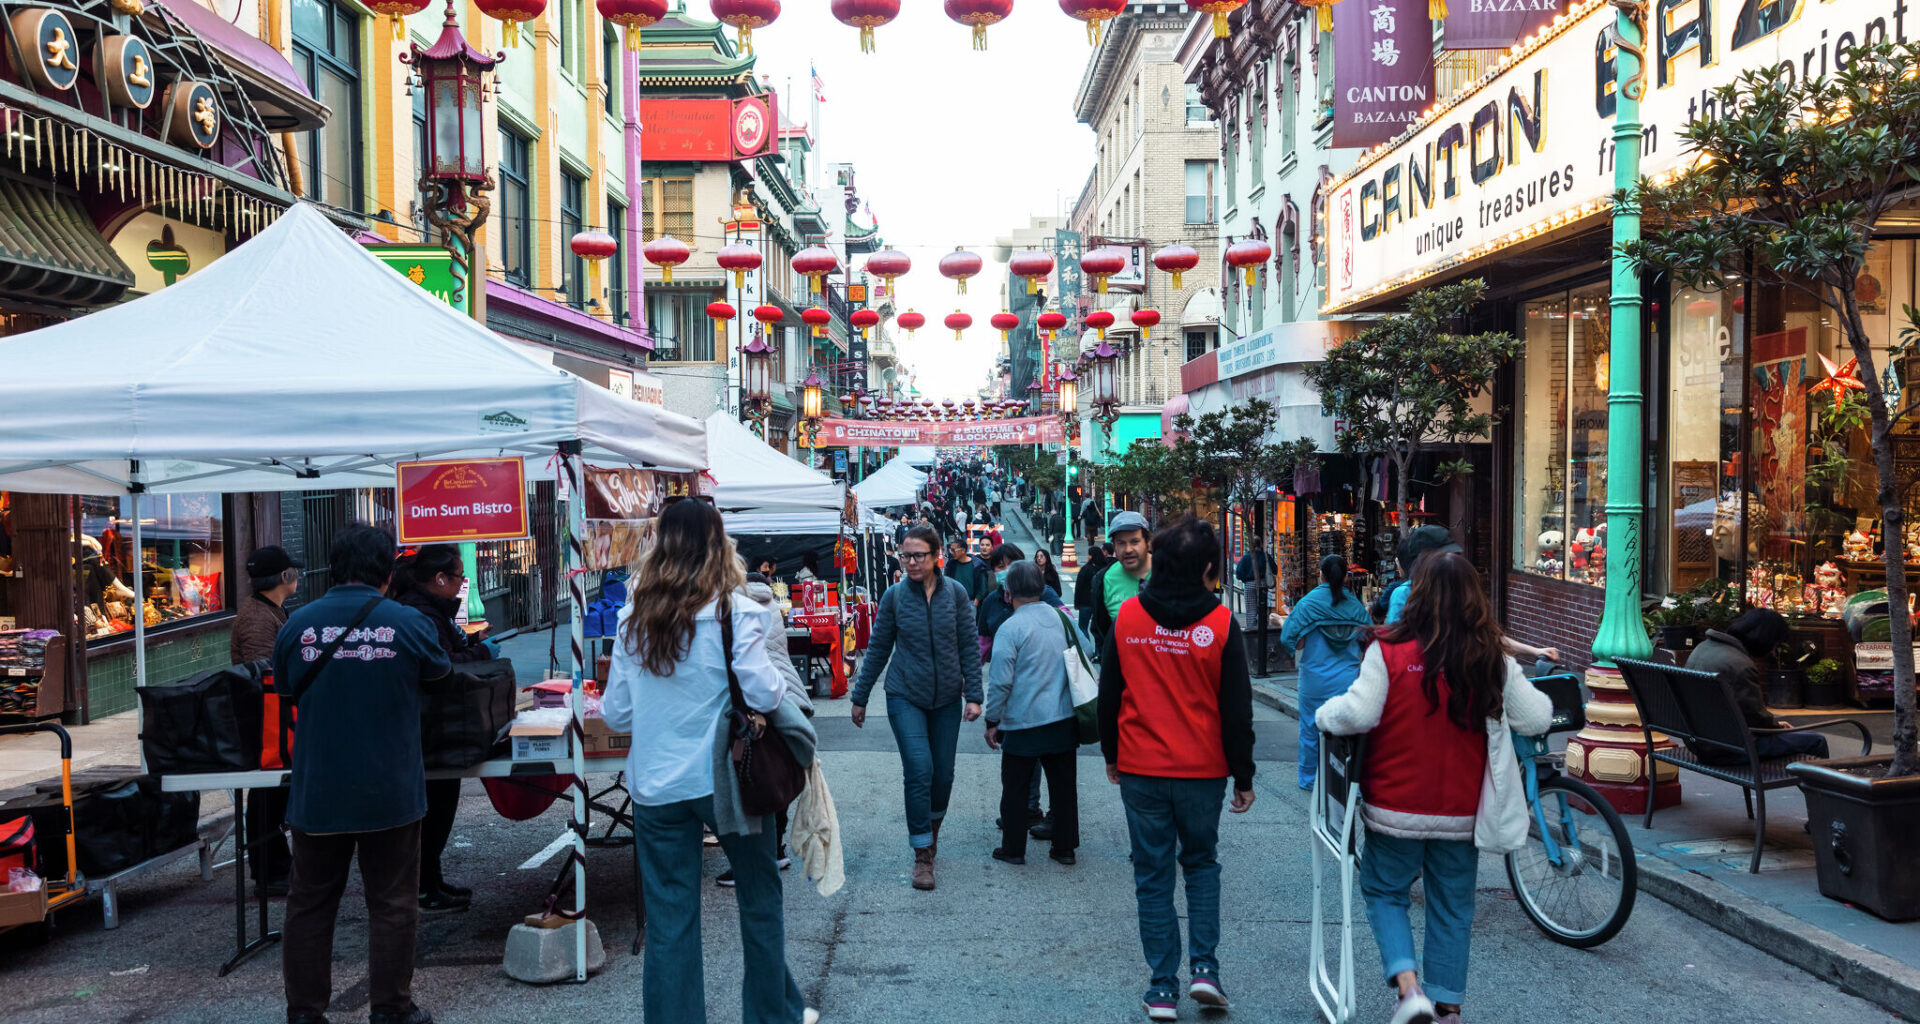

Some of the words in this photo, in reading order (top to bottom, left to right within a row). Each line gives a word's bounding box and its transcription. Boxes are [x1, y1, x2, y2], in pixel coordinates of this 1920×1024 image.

[1470, 0, 1557, 13] BAZAAR
[1369, 0, 1401, 67] 商場
[1347, 85, 1427, 103] CANTON
[1354, 110, 1417, 124] BAZAAR
[1360, 68, 1548, 242] CANTON
[1416, 215, 1463, 256] unique
[1479, 164, 1575, 229] treasures
[1598, 124, 1657, 177] frm
[746, 240, 754, 294] Bnk
[853, 303, 864, 342] FUR
[847, 428, 919, 438] CHINATOWN
[953, 433, 987, 441] BLOCK
[990, 431, 1024, 440] PARTY
[964, 426, 983, 434] BIG
[985, 424, 1014, 433] GAME
[411, 505, 437, 518] Dim
[440, 504, 469, 517] Sum
[473, 502, 512, 515] Bistro
[1155, 625, 1190, 640] Rotary
[1141, 636, 1148, 644] of
[1149, 637, 1160, 645] San
[1161, 639, 1189, 648] Fancisco
[1407, 664, 1424, 673] Club
